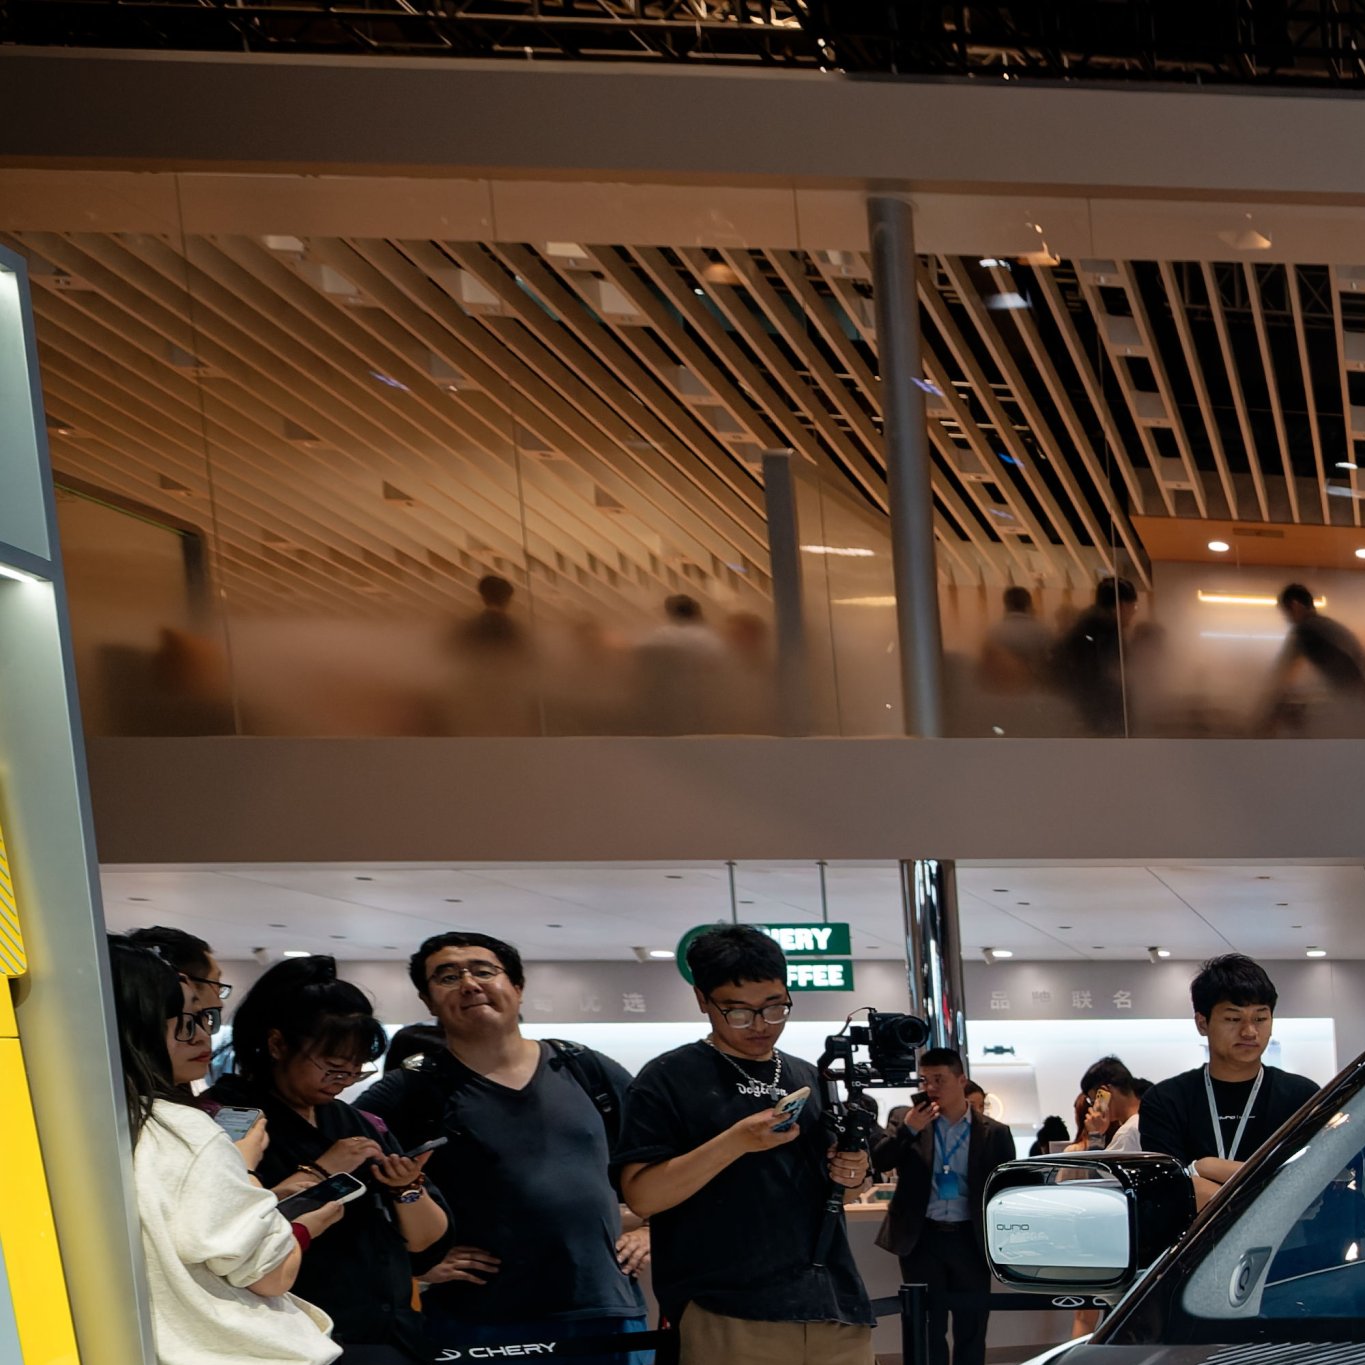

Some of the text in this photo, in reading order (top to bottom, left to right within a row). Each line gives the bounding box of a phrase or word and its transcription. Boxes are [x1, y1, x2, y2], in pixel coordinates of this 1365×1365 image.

[763, 927, 832, 951] ERY
[786, 964, 845, 987] FFEE
[468, 1341, 556, 1358] CHERY
